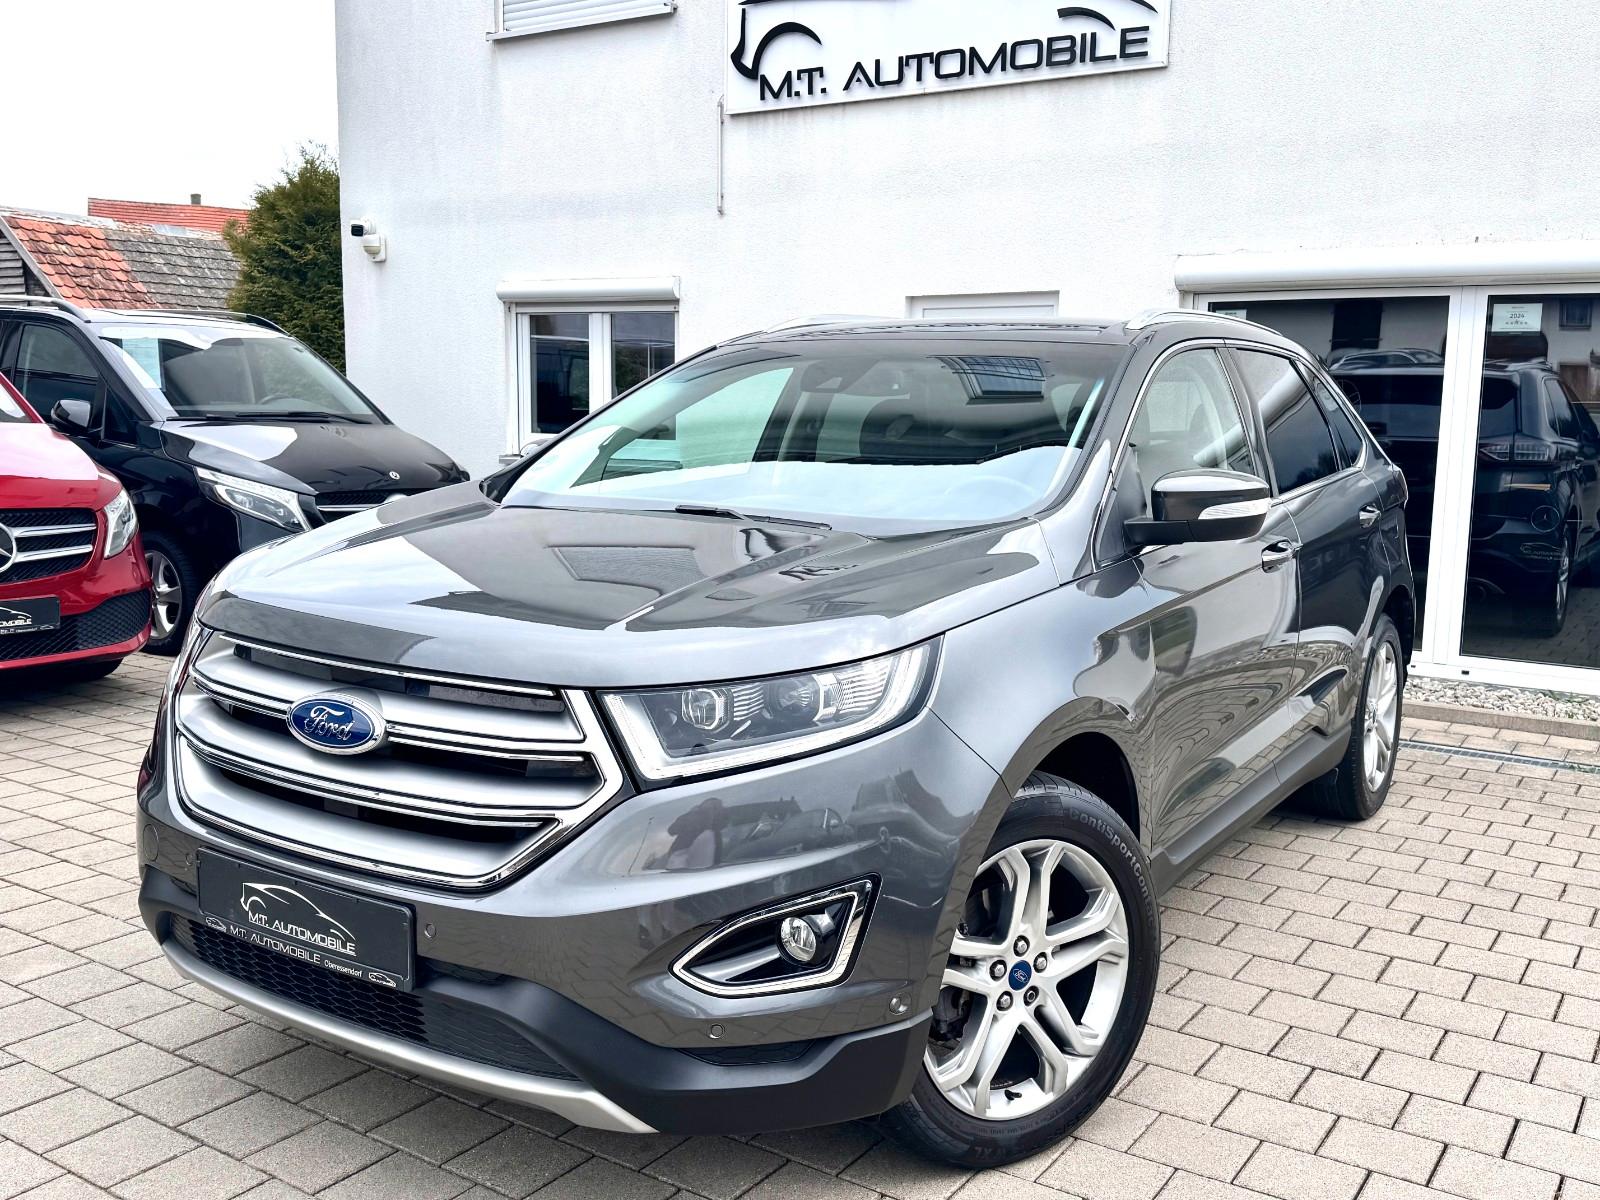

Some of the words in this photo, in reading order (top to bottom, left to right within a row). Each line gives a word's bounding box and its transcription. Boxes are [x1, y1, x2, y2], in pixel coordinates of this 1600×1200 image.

[759, 67, 827, 100] M.T.
[843, 25, 1151, 91] AUTOMOBILE
[303, 705, 355, 740] Ford
[230, 925, 248, 939] M.T.
[250, 933, 321, 964] AUTOMOBILE
[248, 911, 269, 928] M.T.
[272, 919, 356, 954] AUTOMOBILE
